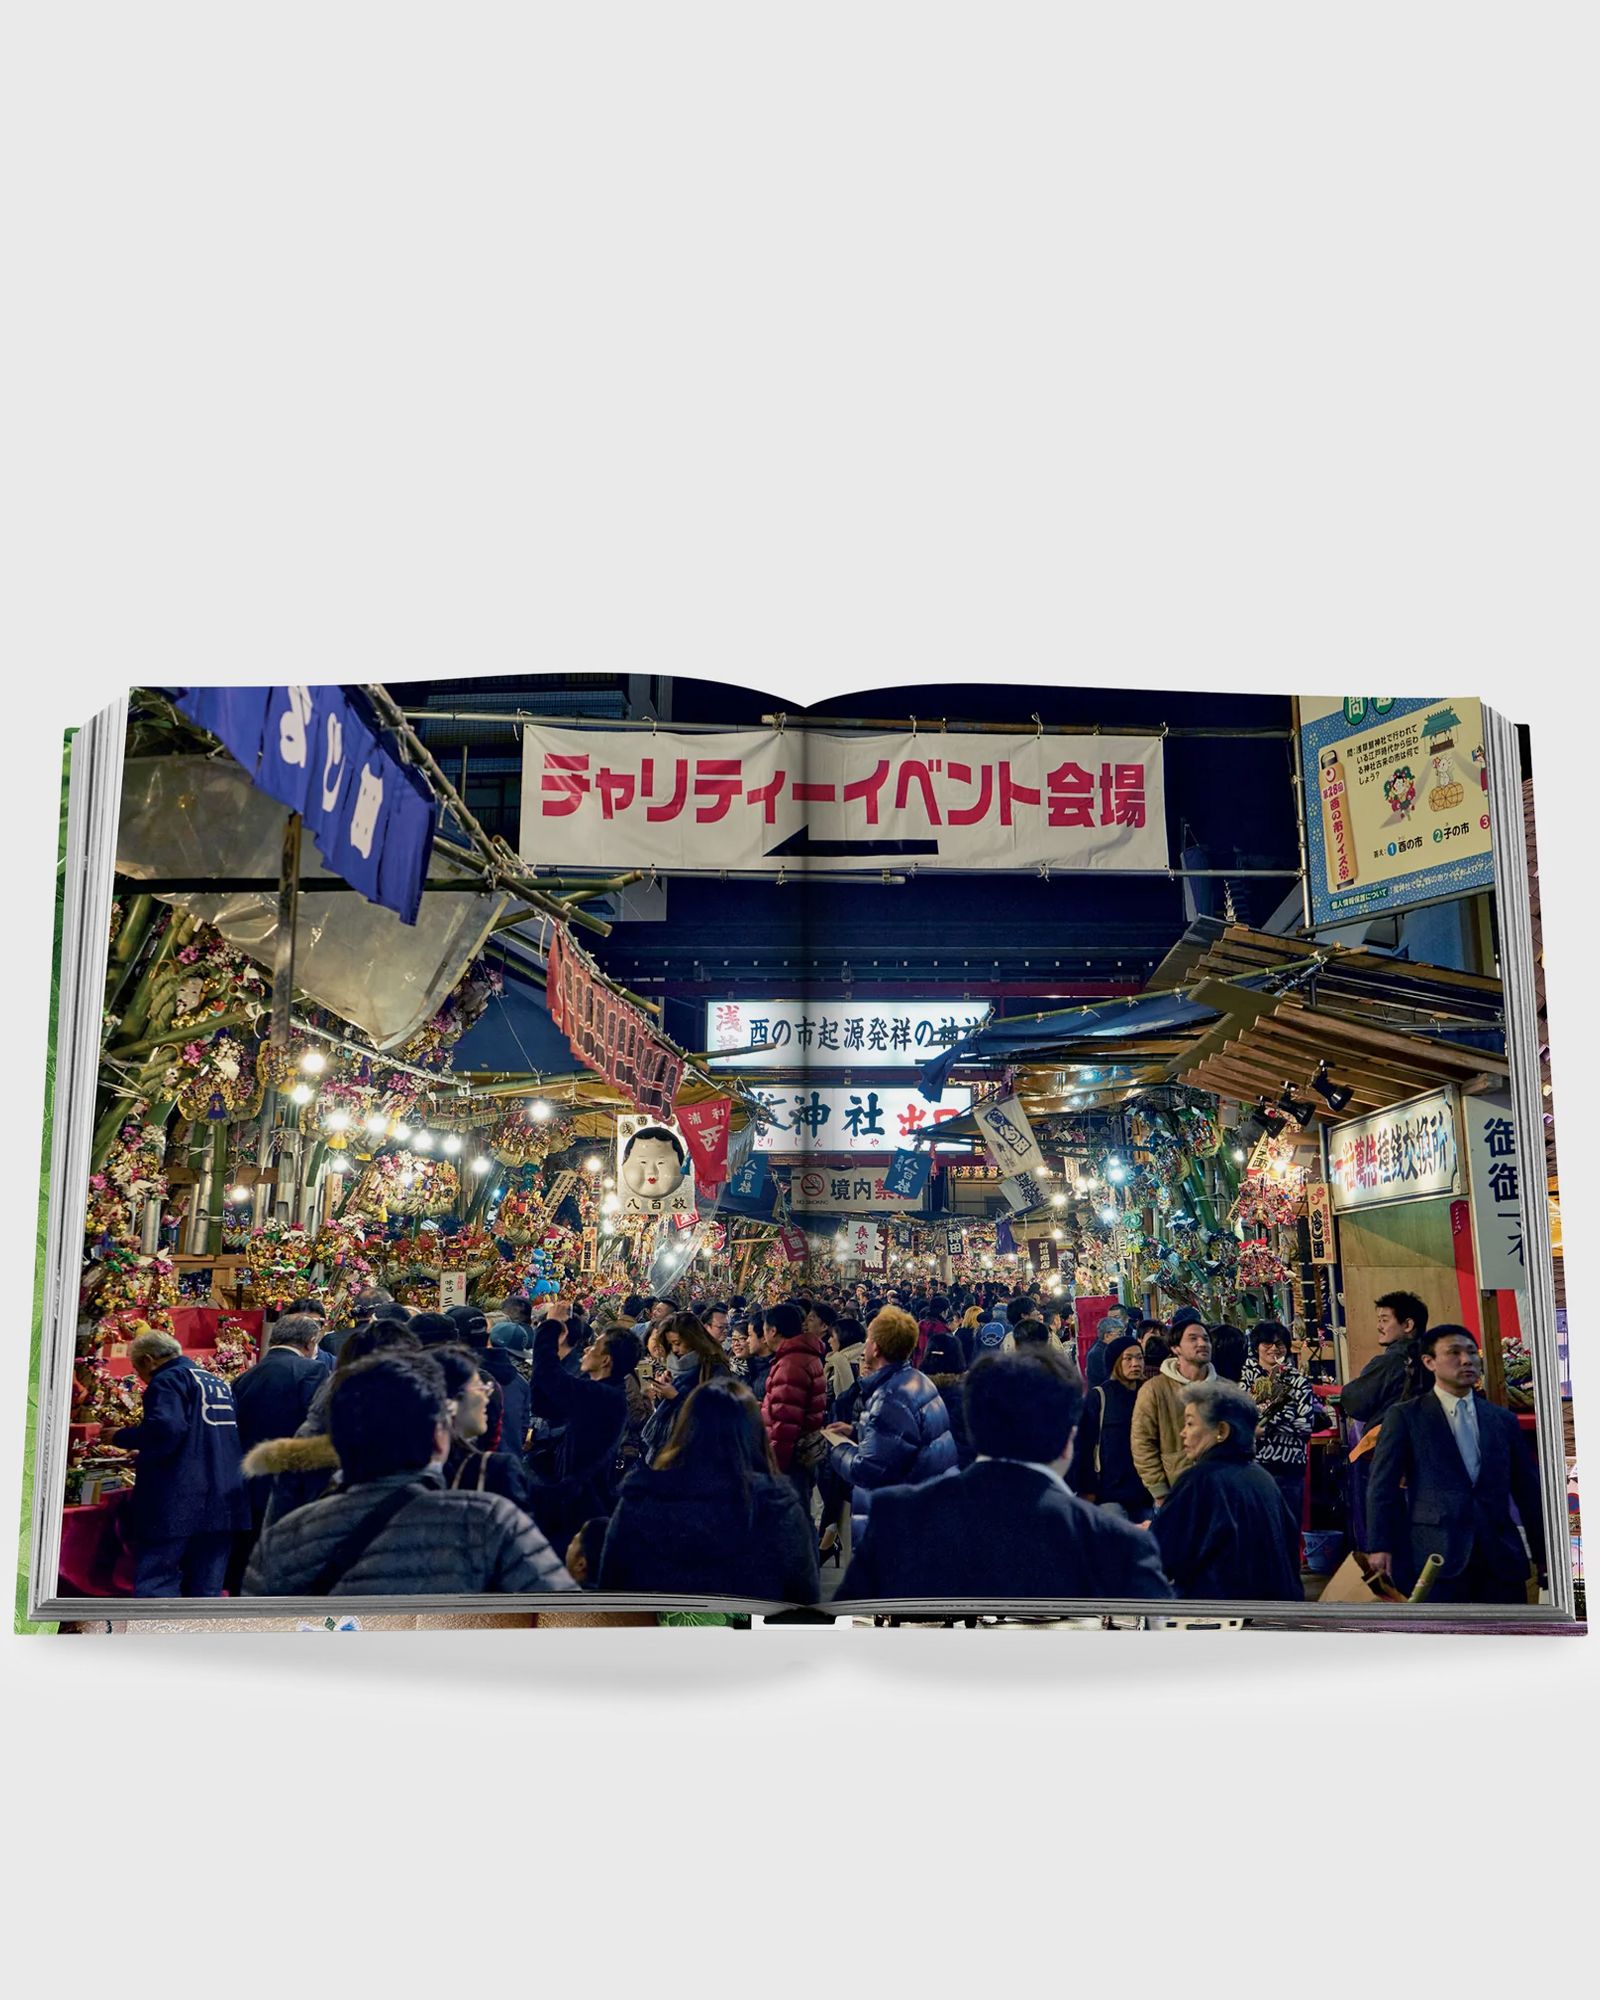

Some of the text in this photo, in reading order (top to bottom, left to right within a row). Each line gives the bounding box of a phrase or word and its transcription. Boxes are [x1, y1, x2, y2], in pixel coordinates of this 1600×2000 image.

[541, 752, 1146, 829] チャリティーイベント会場
[830, 1178, 913, 1201] 境内禁
[948, 1231, 962, 1254] 神田
